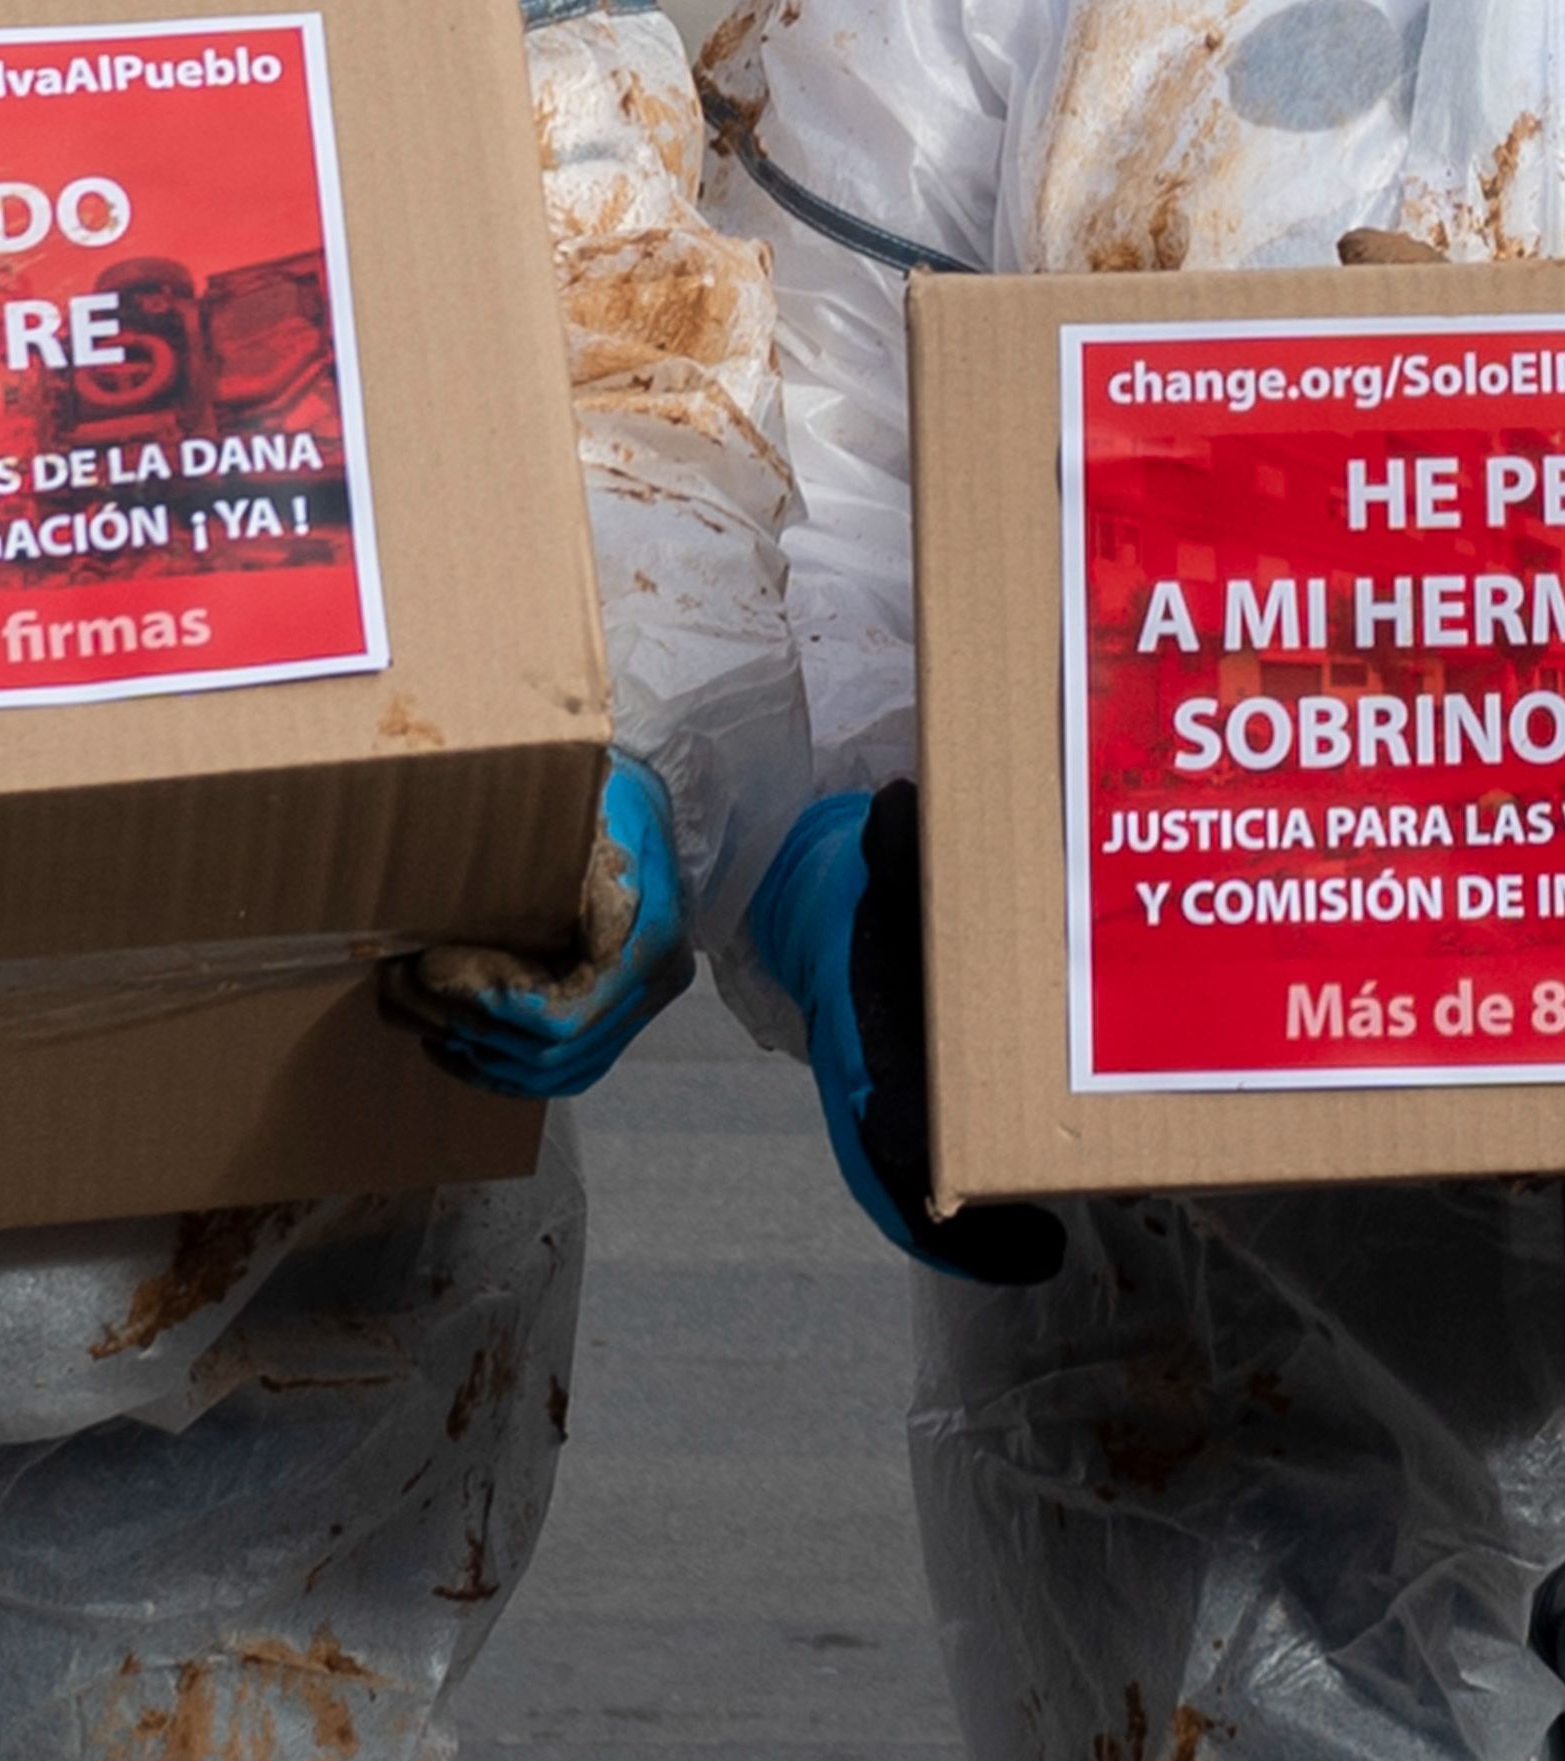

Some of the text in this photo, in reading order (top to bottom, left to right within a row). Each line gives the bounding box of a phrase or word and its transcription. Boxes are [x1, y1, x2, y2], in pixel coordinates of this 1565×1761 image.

[32, 449, 98, 491] DE
[107, 443, 171, 484] LA
[181, 432, 323, 477] DANA
[1347, 457, 1462, 531] HE
[1, 607, 212, 663] firmas
[1137, 580, 1200, 653] A
[1224, 578, 1327, 651] MI
[1102, 807, 1315, 853] JUSTICIA
[1327, 805, 1454, 849] PARA
[1465, 802, 1554, 846] LAS
[1136, 881, 1171, 926] Y
[1182, 867, 1443, 925] COMISIÓN
[1457, 874, 1525, 920] DE
[1286, 980, 1417, 1040] Más
[1433, 977, 1515, 1037] de
